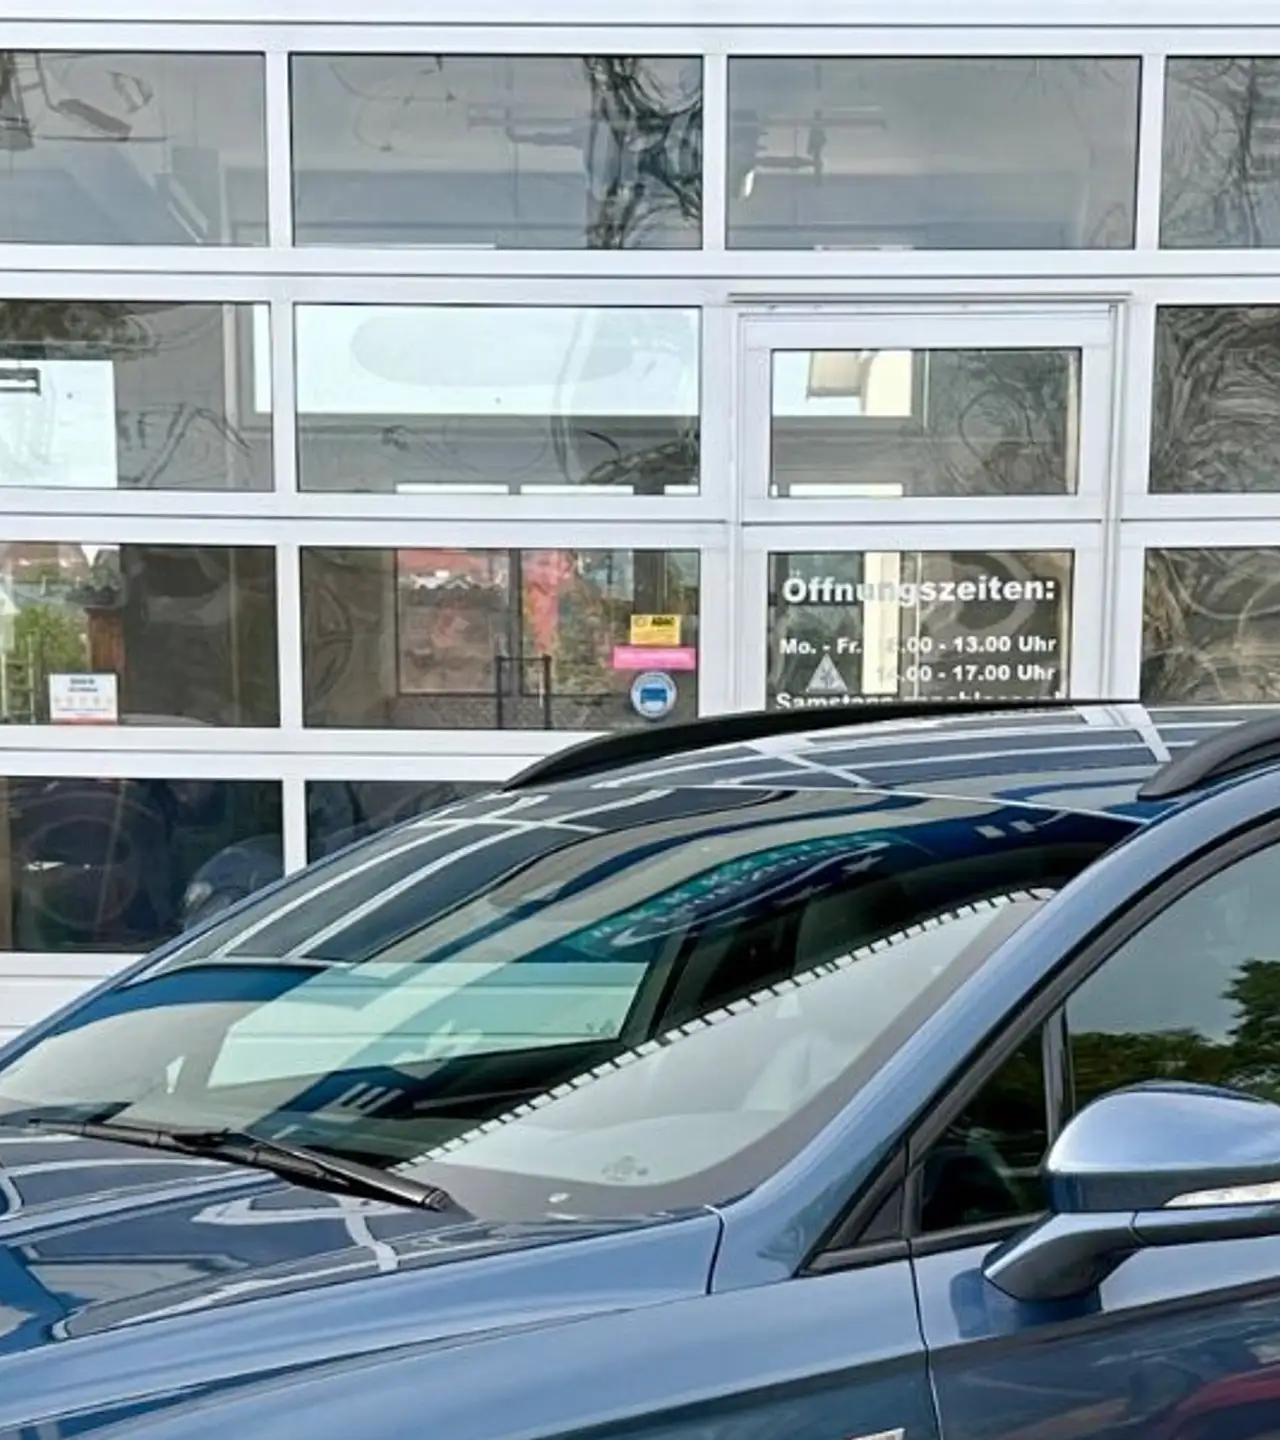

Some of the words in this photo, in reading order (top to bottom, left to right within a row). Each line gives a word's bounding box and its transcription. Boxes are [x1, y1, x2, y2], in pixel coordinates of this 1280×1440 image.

[782, 568, 1055, 607] Öffnungszeiten:
[779, 637, 817, 655] Mo.
[836, 636, 863, 655] Fr.
[953, 635, 1012, 653] 13.00
[1018, 635, 1058, 653] Uhr
[952, 664, 1012, 682] 17.00
[1017, 664, 1056, 682] Uhr
